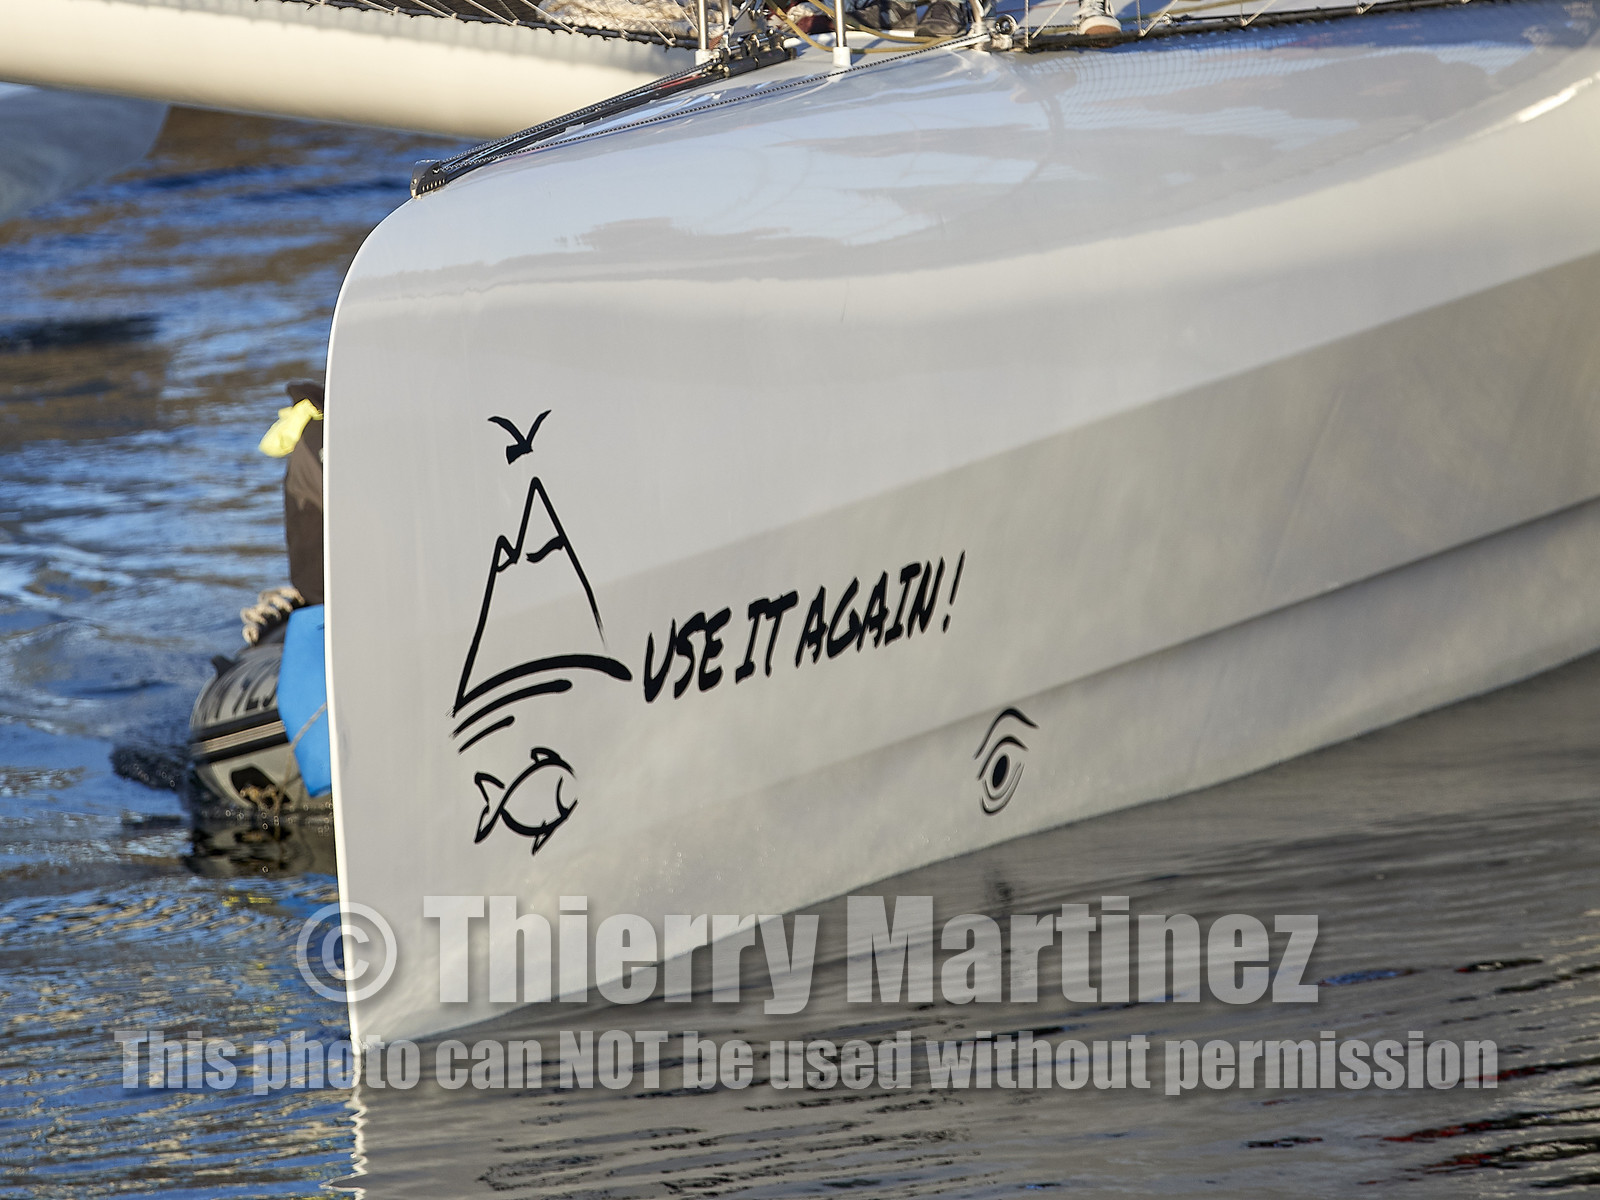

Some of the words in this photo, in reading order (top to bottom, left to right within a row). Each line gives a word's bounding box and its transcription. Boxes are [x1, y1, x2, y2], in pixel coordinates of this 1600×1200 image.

[643, 607, 732, 703] USE
[735, 590, 799, 684] IT
[795, 551, 965, 668] AGAIN!
